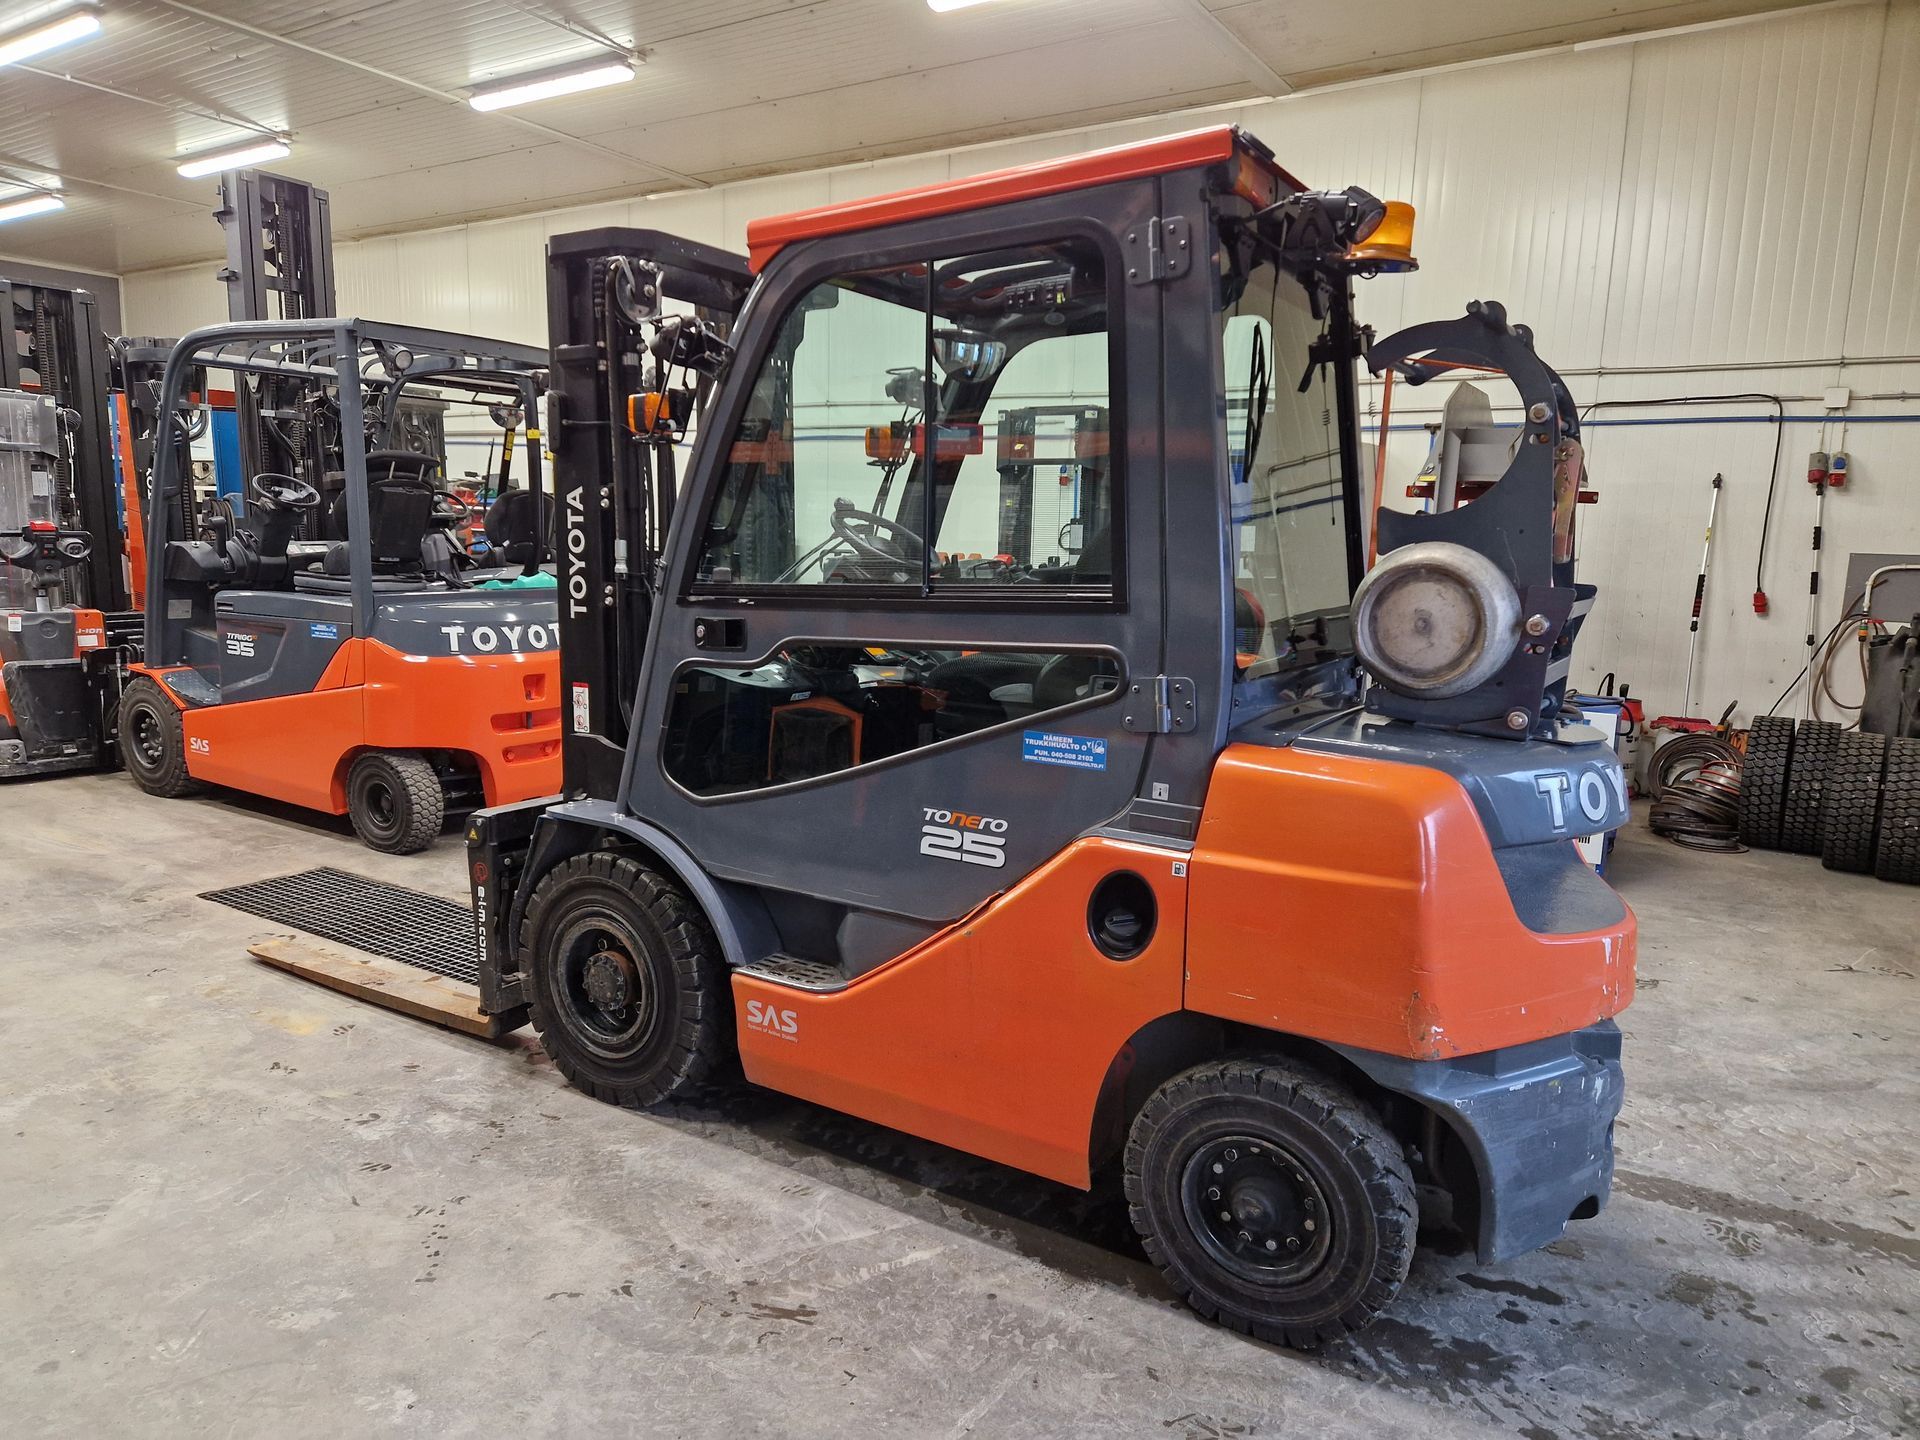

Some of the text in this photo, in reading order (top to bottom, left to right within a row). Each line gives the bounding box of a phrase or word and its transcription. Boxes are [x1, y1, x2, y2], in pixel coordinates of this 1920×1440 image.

[566, 486, 588, 619] TOYOTA
[226, 639, 255, 658] 35
[441, 622, 560, 653] TOYOT
[190, 736, 209, 752] SAS
[1024, 738, 1080, 751] TRUKKIHUOLTO
[1043, 734, 1073, 744] HÄMEEN
[1077, 754, 1094, 762] 2102
[923, 807, 1008, 833] TONERO
[920, 825, 1006, 868] 25
[746, 999, 798, 1034] SAS
